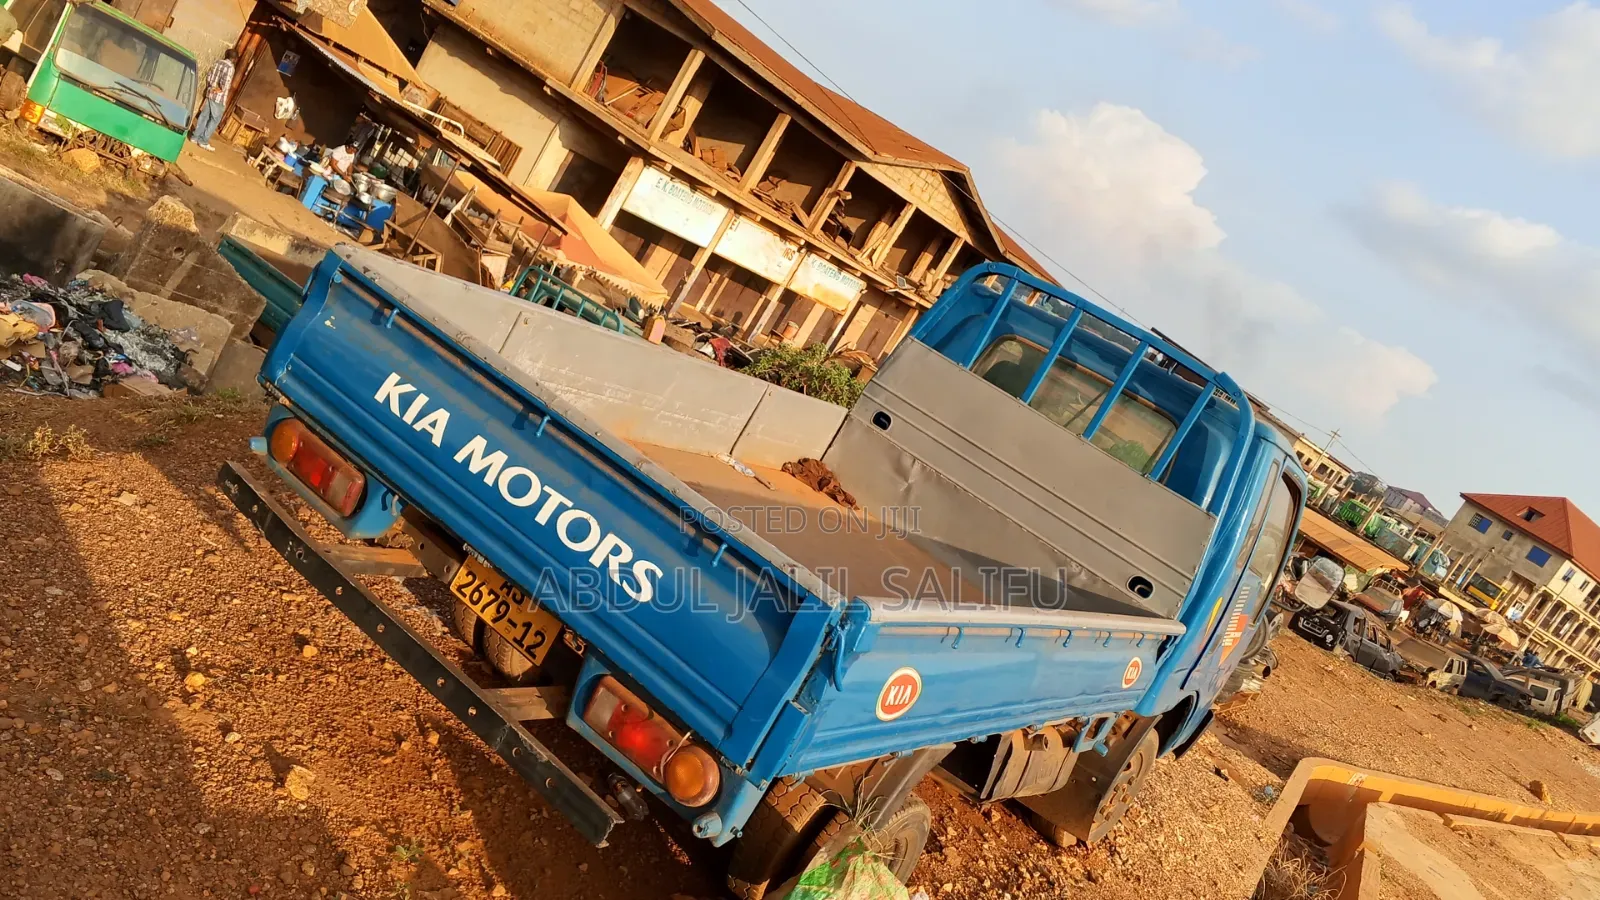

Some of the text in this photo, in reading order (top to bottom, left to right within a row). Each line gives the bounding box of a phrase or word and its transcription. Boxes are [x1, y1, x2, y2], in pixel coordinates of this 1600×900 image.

[374, 371, 664, 603] KIA MOTORS
[456, 570, 547, 660] 2679-12
[884, 684, 913, 707] KIA
[1125, 666, 1139, 680] KIA
